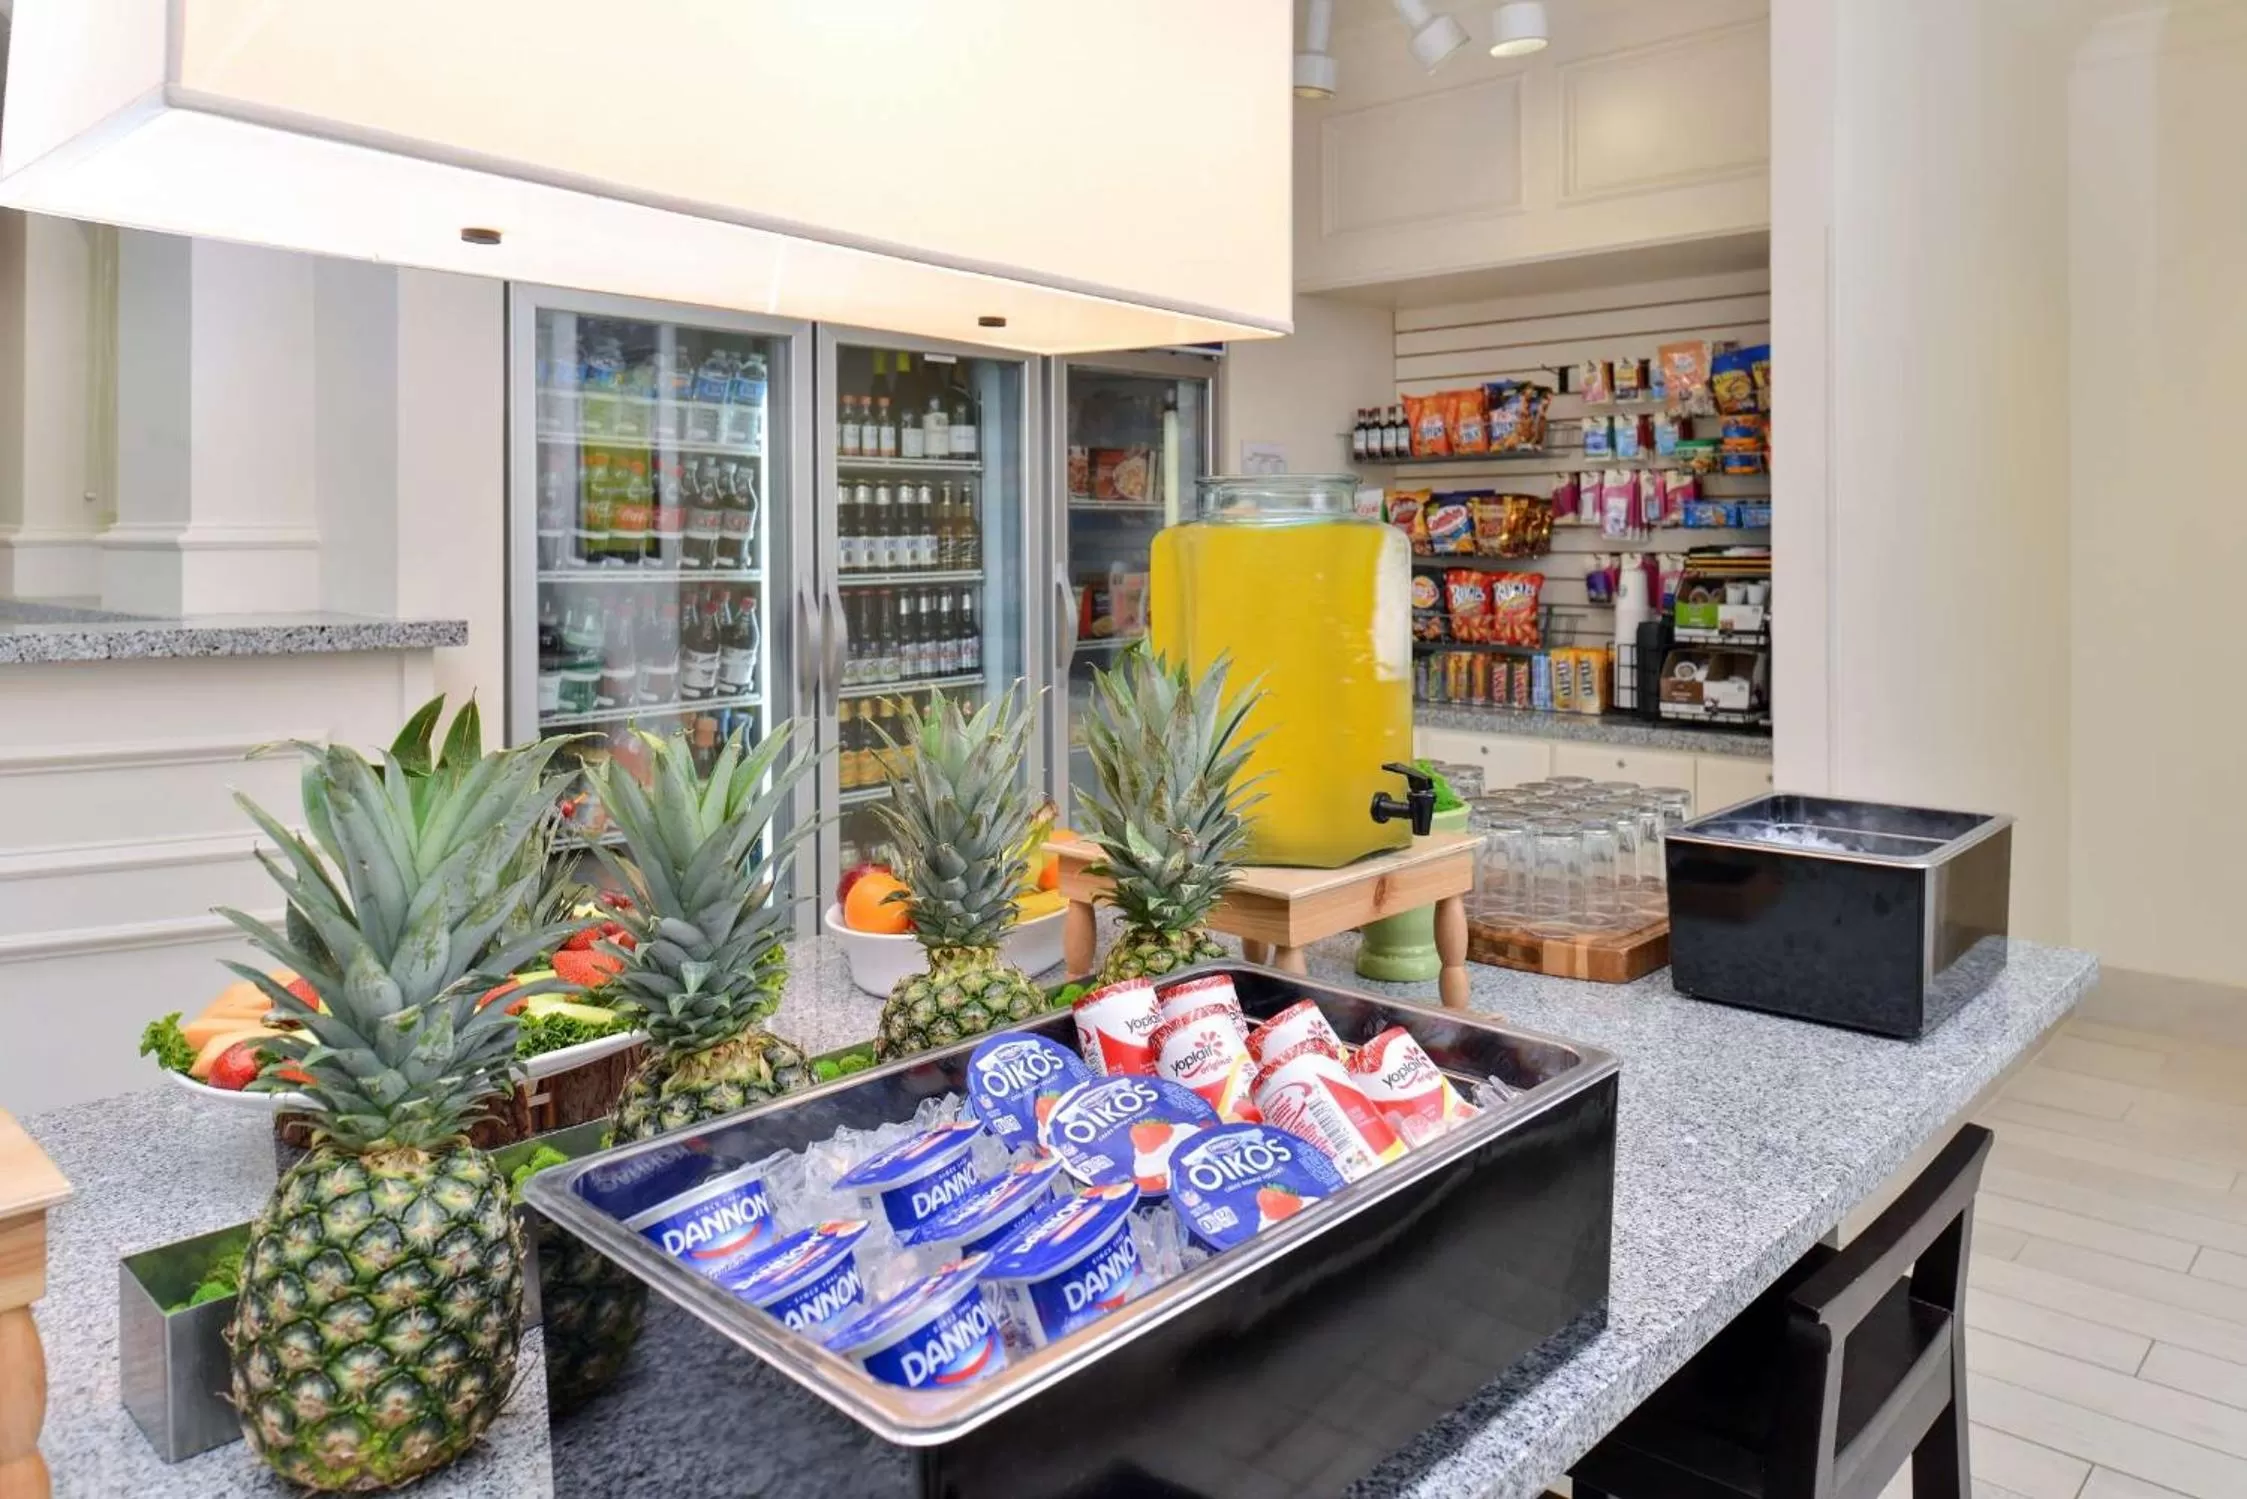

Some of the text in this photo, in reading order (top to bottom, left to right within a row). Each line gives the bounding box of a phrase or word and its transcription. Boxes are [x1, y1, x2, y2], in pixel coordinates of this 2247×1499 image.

[1124, 1013, 1162, 1034] Yopla
[982, 1047, 1065, 1098] OIKOS
[1170, 1044, 1212, 1077] Yoplait
[1381, 1057, 1424, 1090] Yoplait
[1064, 1083, 1160, 1144] OIKOS
[911, 1161, 978, 1220] DANNO
[1188, 1139, 1293, 1192] OIKOS
[662, 1191, 771, 1256] DANNON
[784, 1266, 863, 1331] ANNON
